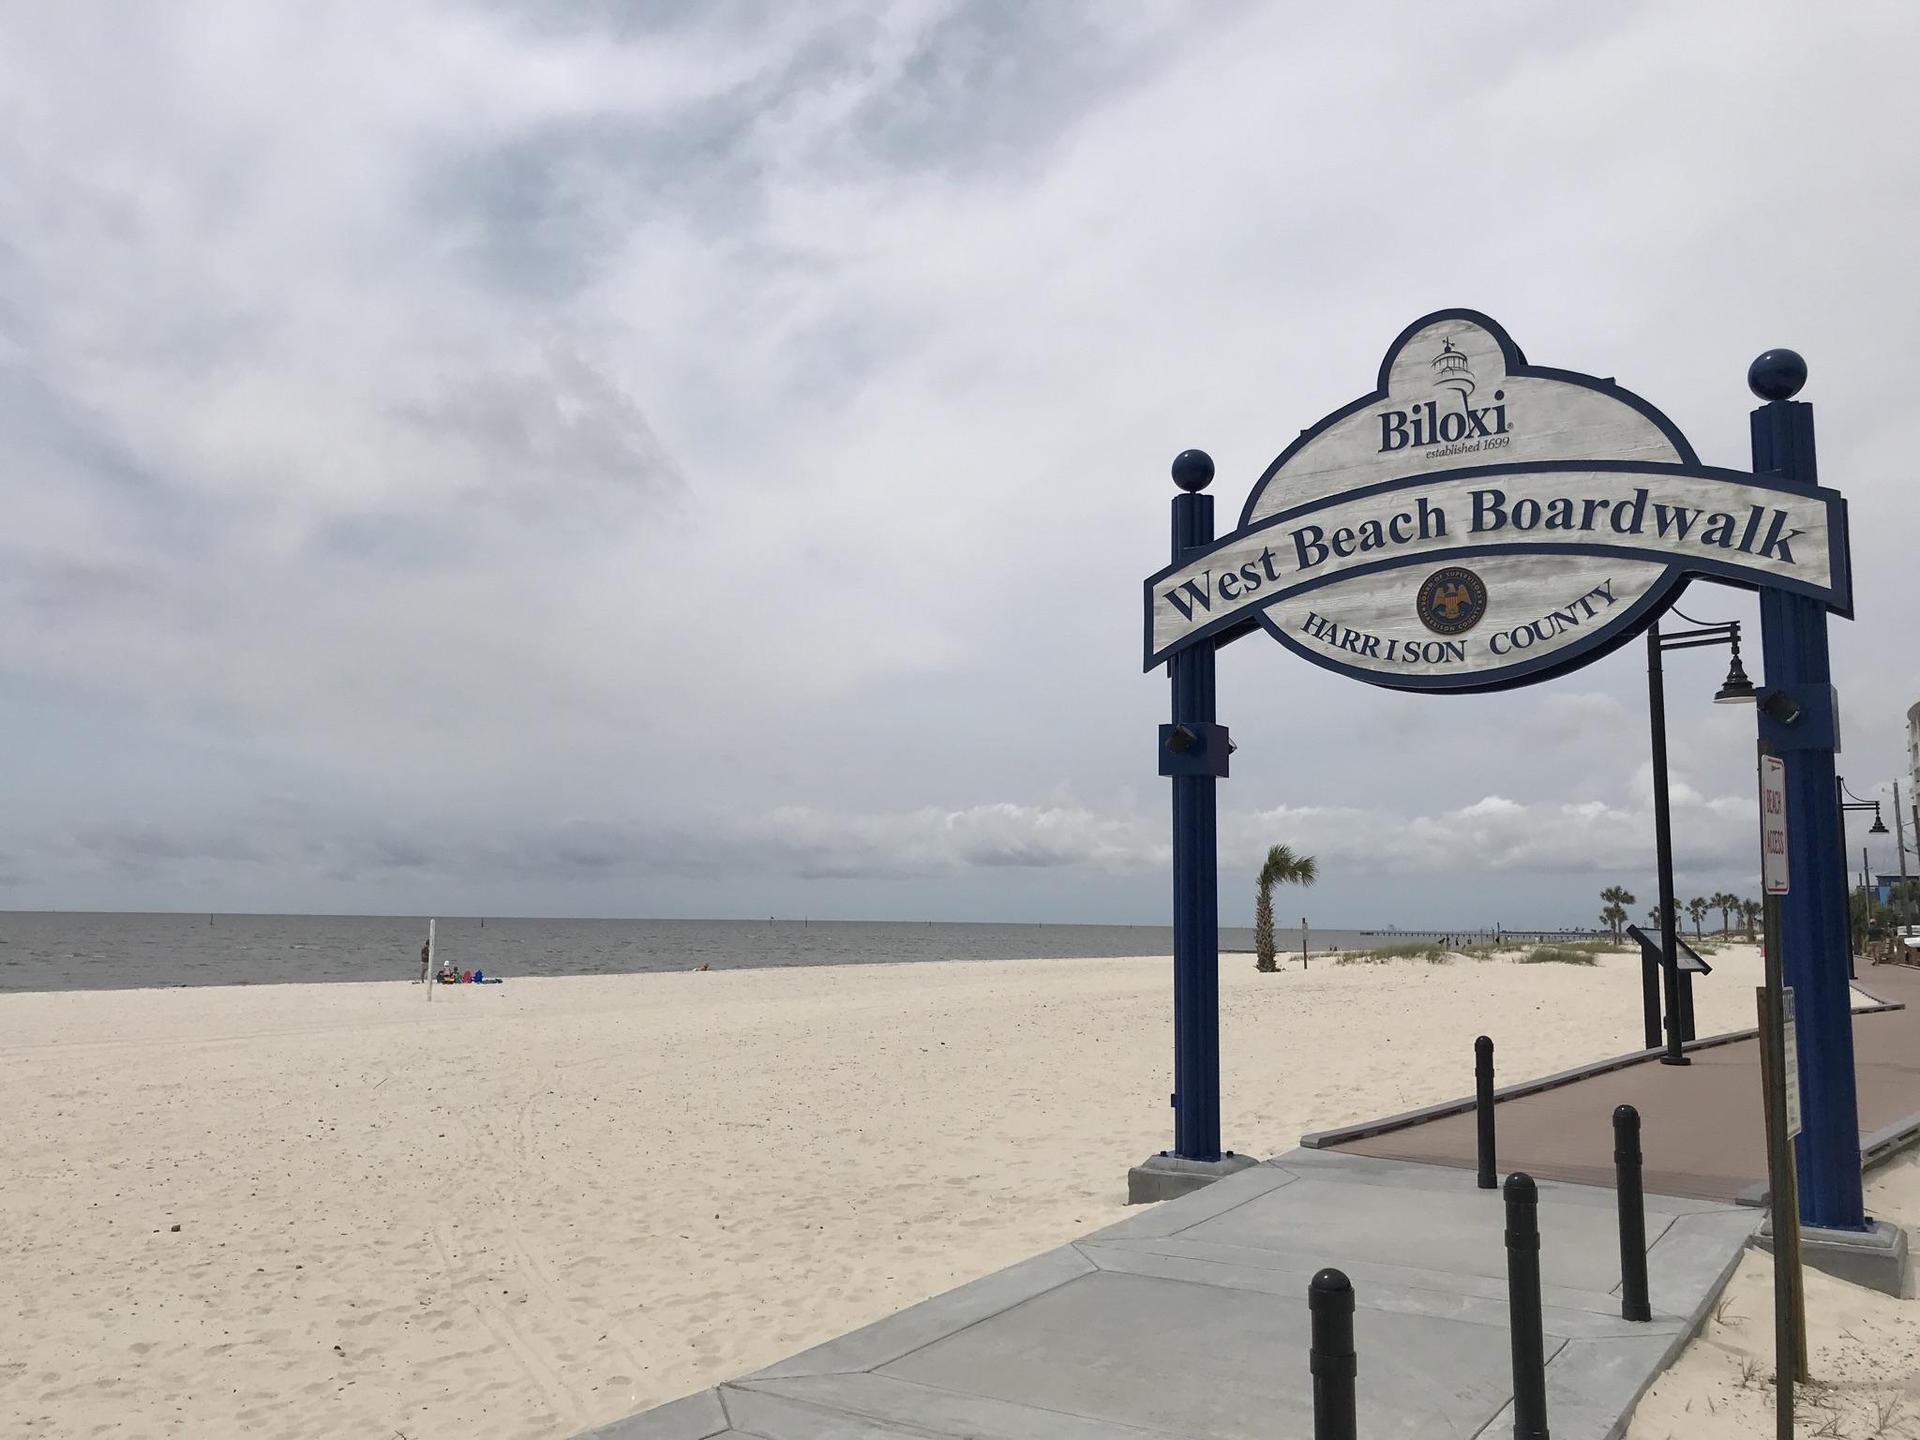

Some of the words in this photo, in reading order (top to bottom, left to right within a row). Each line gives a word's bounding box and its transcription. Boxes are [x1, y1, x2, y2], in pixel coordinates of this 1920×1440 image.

[1377, 389, 1510, 454] Biloxi
[1425, 440, 1480, 459] established
[1483, 436, 1511, 451] 1699
[1163, 546, 1282, 622] West
[1288, 497, 1448, 572] Beach
[1466, 488, 1806, 566] Boardwalk
[1300, 611, 1468, 664] HARRISON
[1489, 577, 1619, 656] COUNTY
